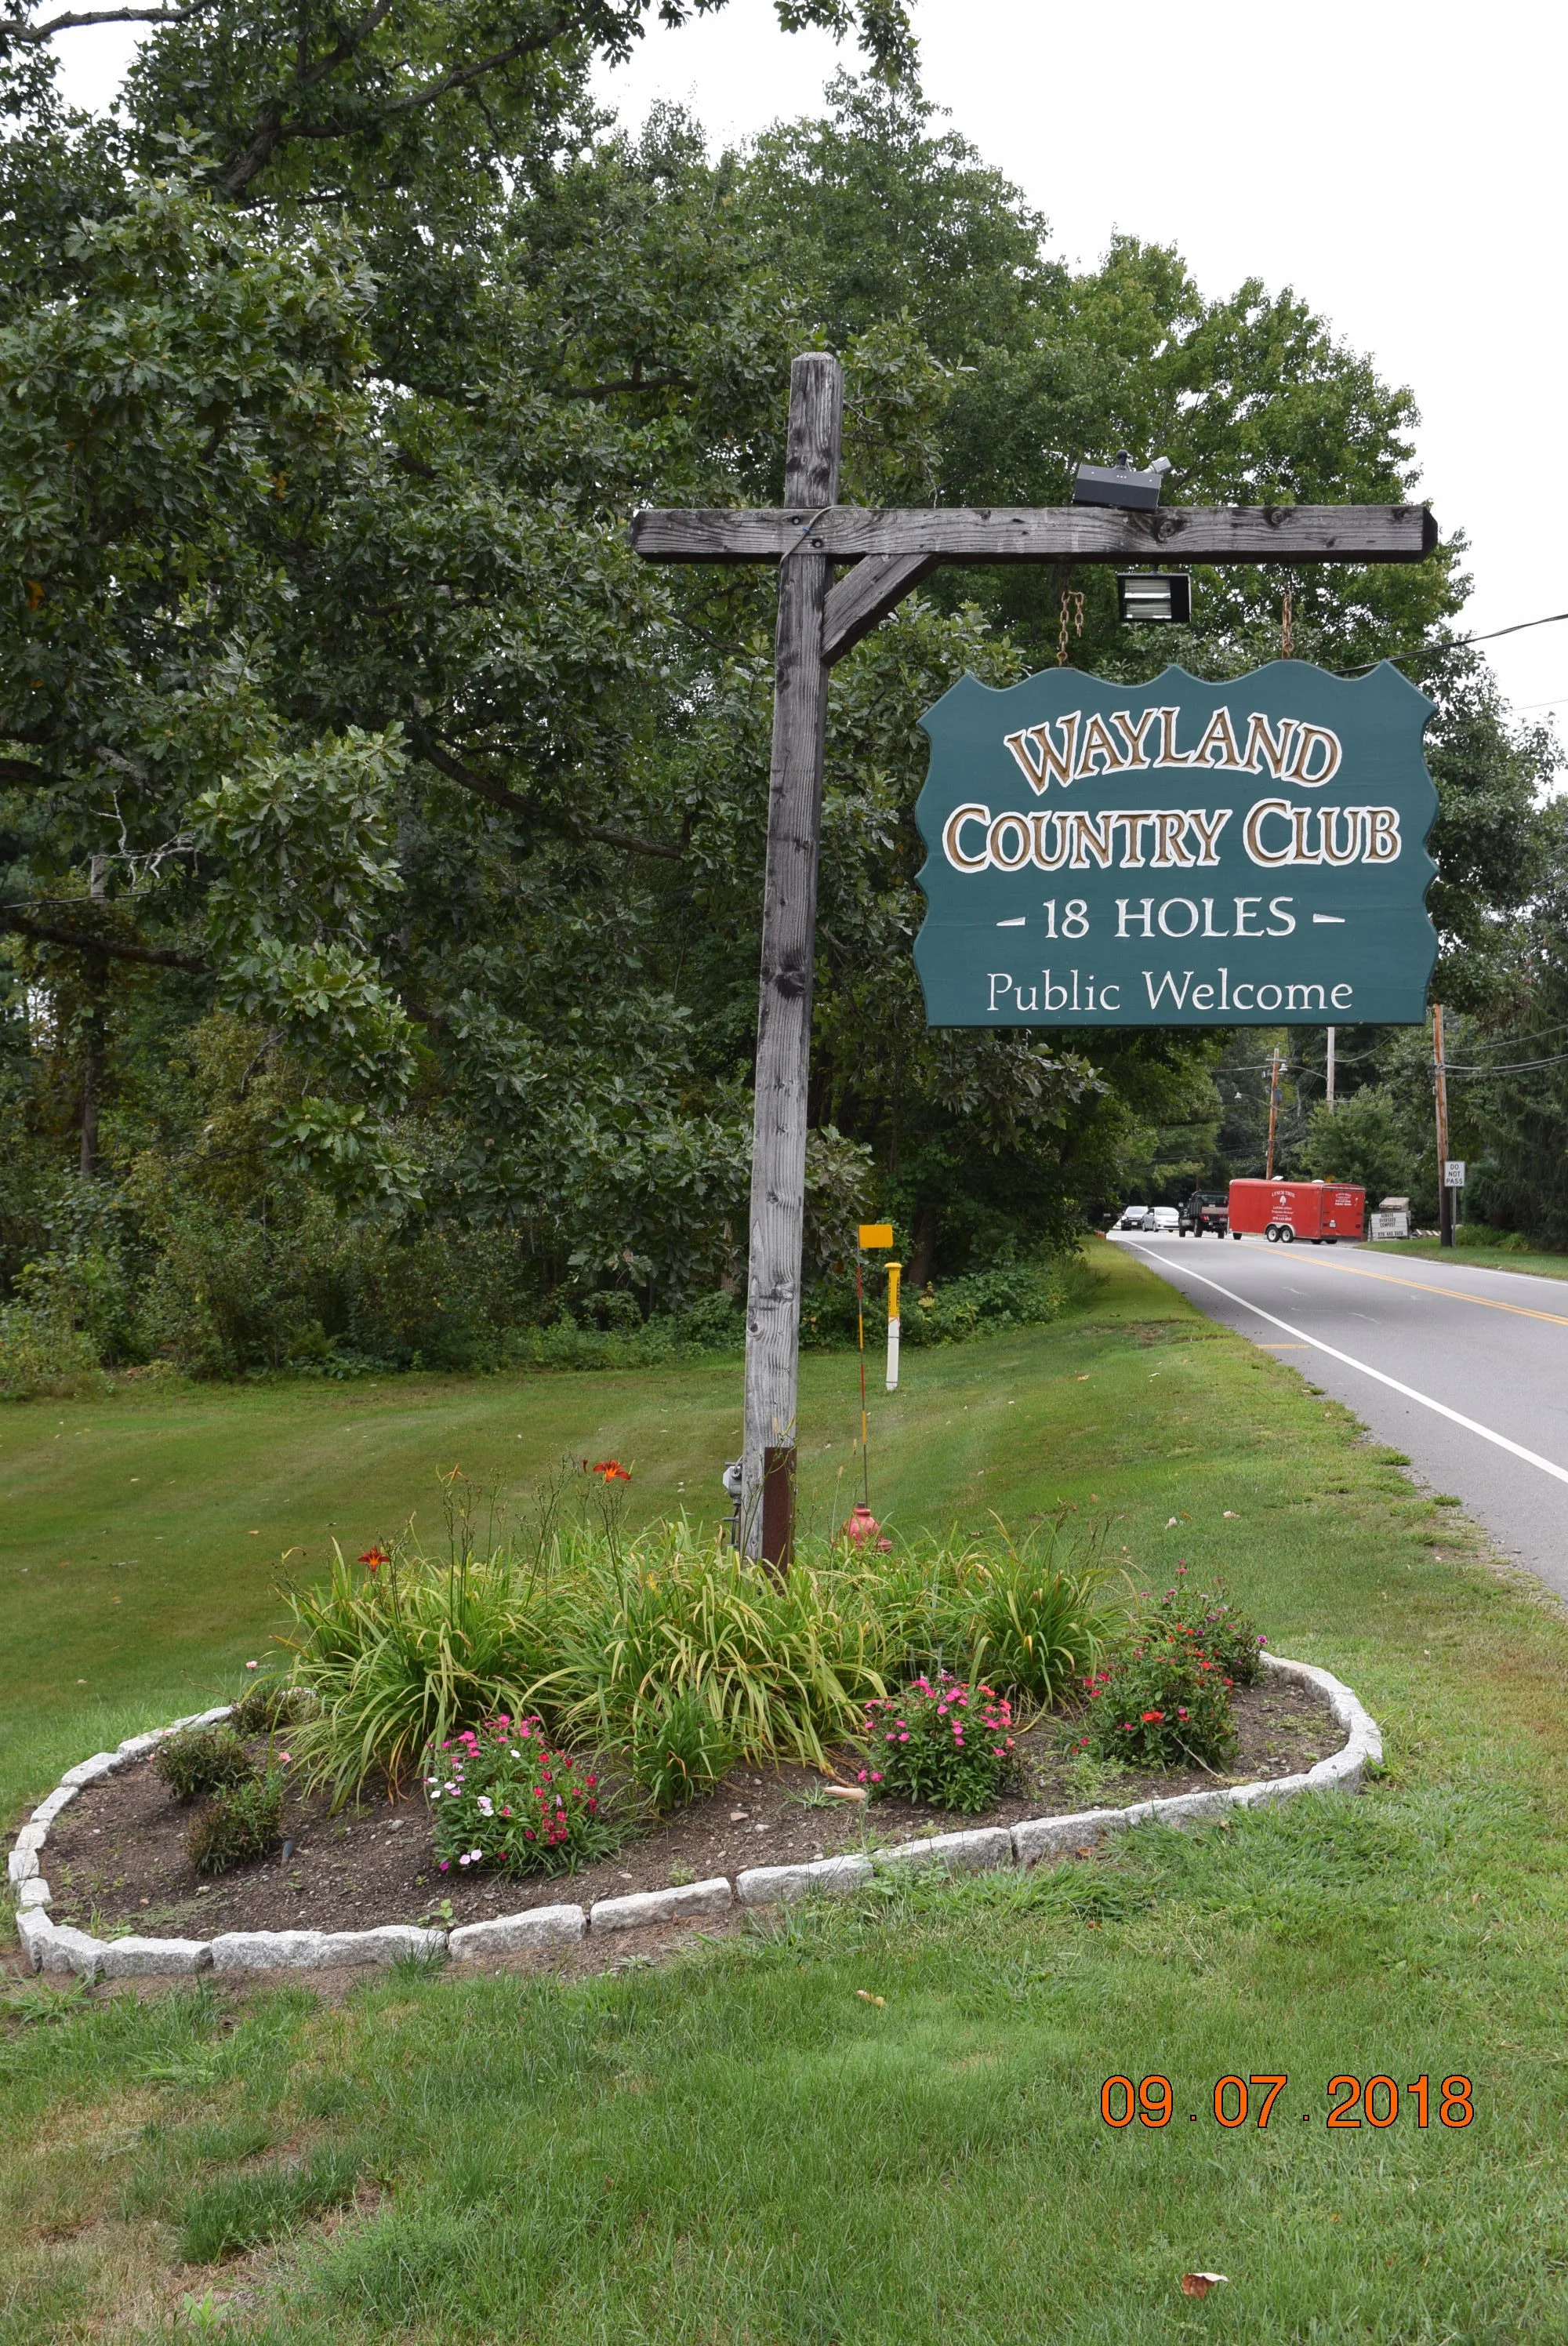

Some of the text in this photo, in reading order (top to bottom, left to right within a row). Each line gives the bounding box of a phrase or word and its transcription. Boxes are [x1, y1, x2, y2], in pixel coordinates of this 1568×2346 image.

[1004, 706, 1342, 796] WAYLAND
[942, 798, 1402, 873] COUNTRY CLUB
[1043, 896, 1296, 939] 18 HOLES
[987, 968, 1353, 1011] Public Welcome
